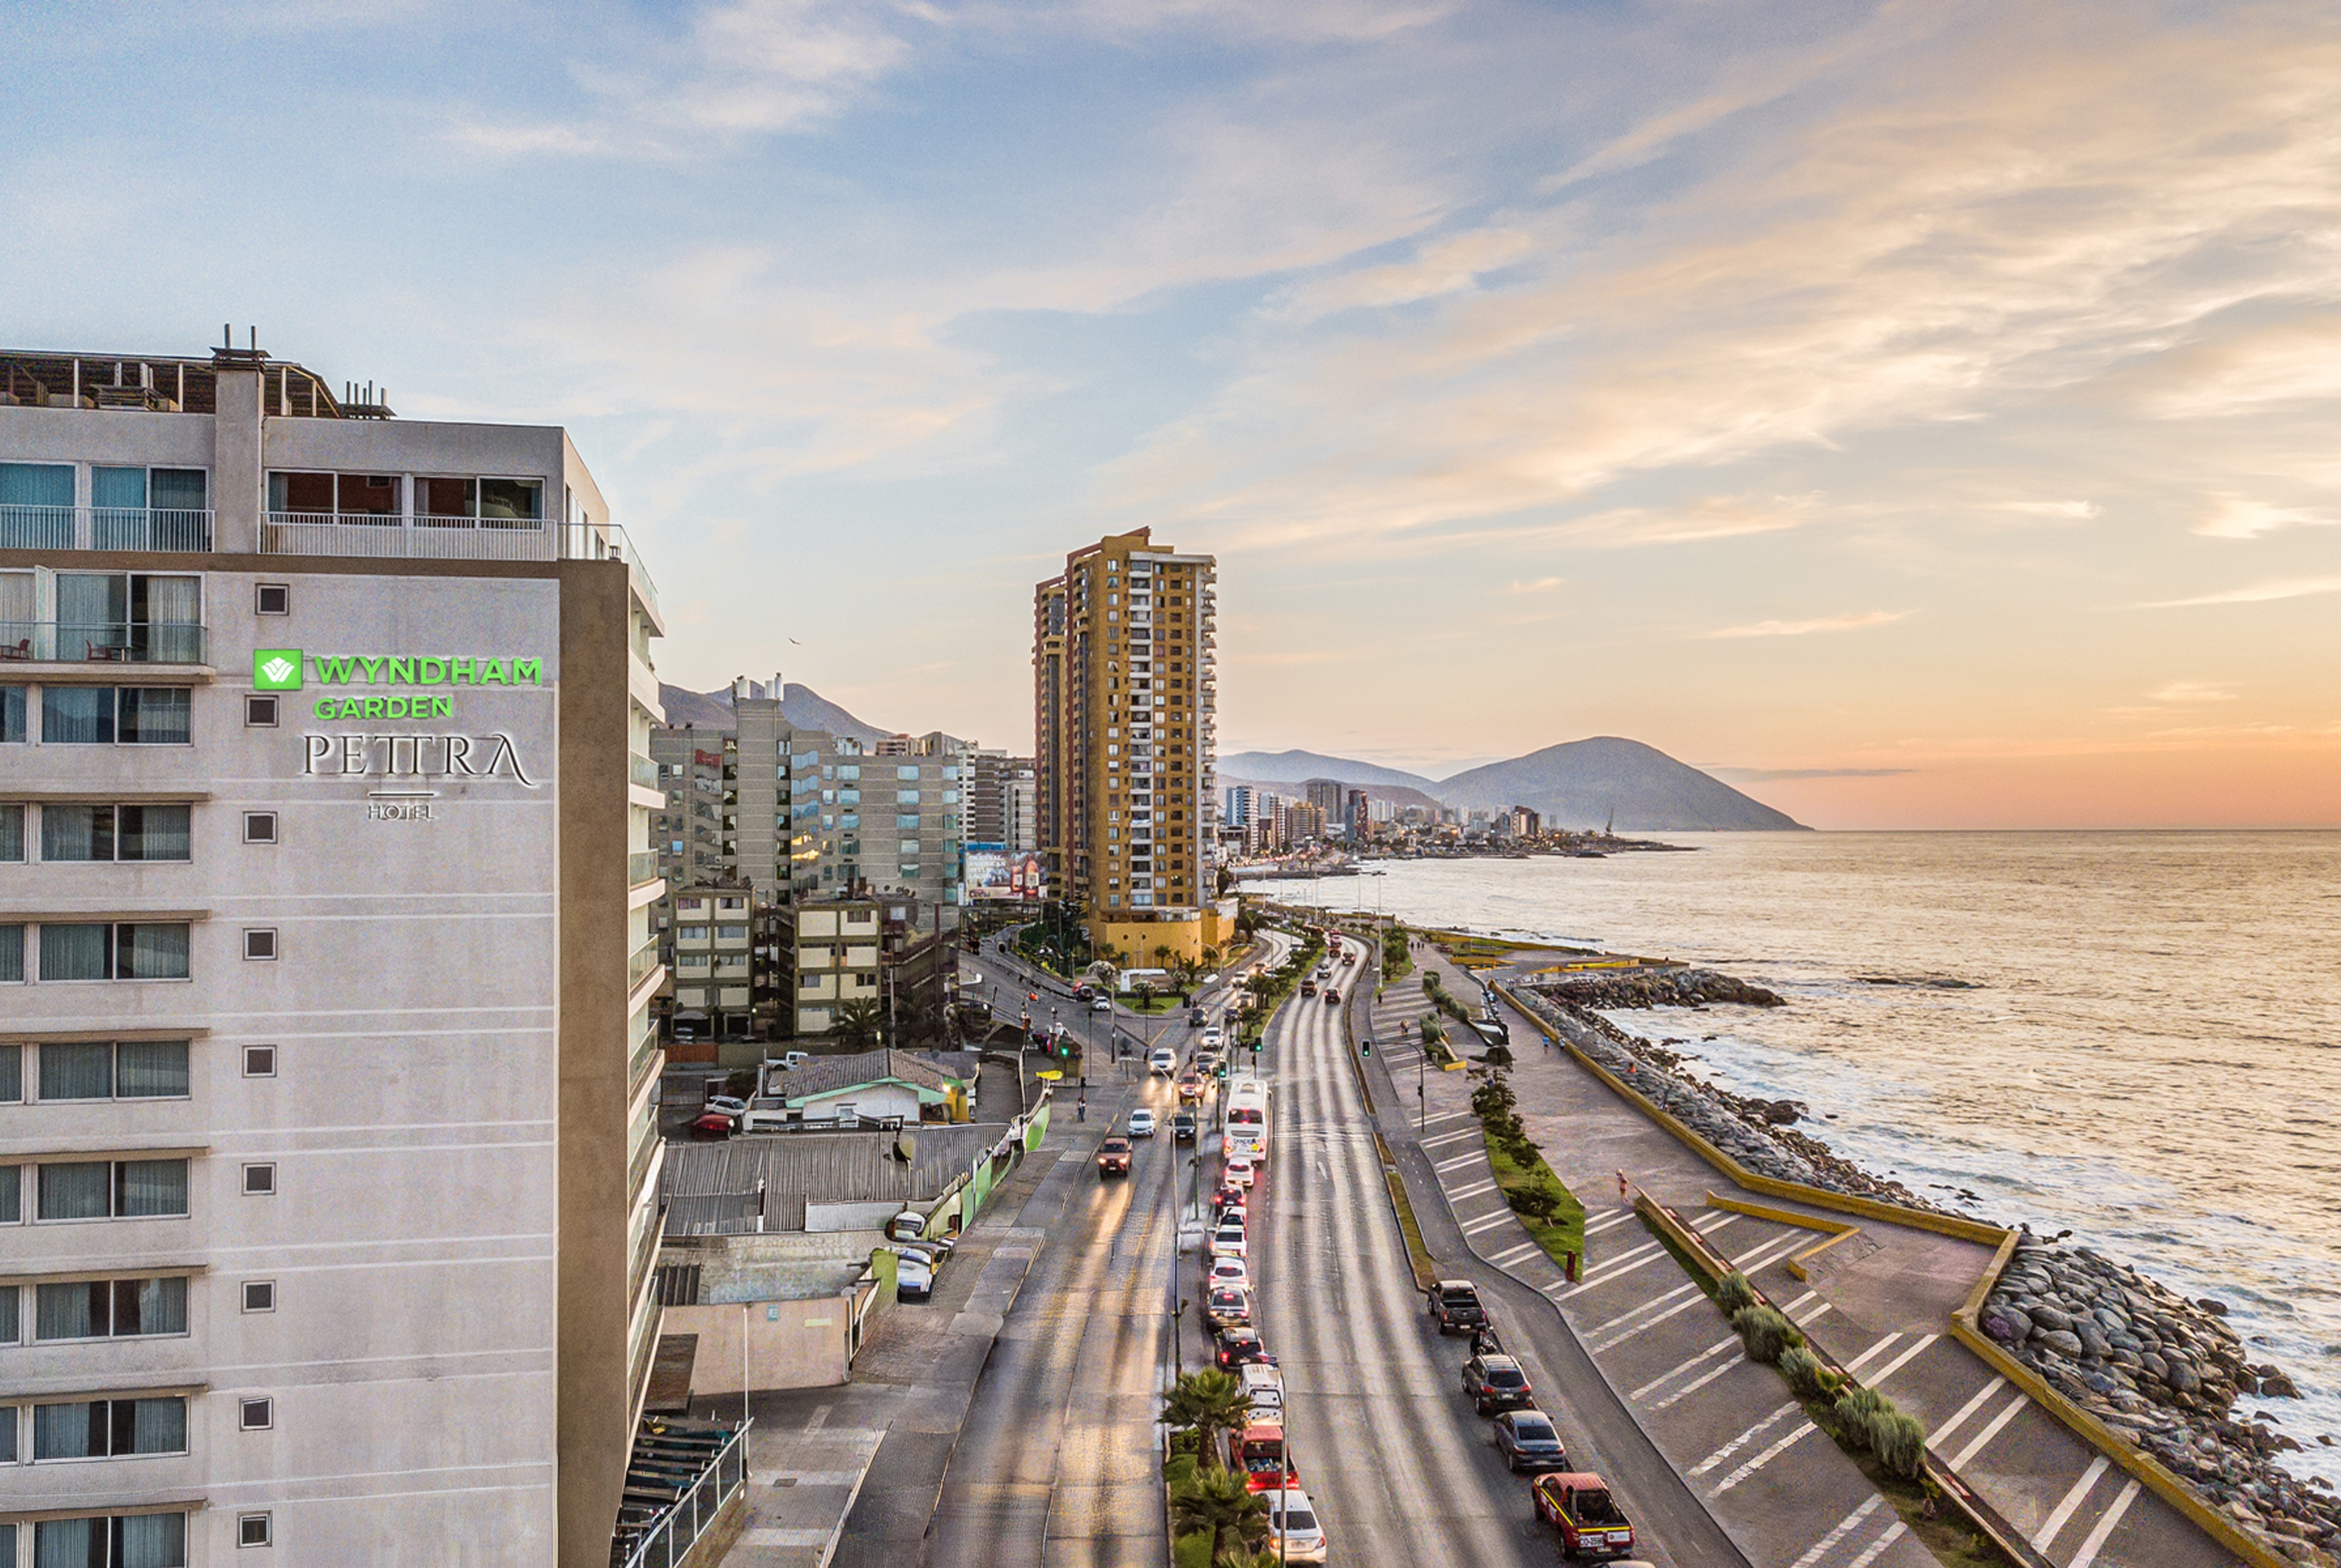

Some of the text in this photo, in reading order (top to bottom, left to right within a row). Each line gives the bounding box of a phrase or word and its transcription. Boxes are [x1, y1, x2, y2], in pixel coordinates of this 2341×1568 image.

[313, 656, 542, 686] WYNDHAM
[313, 696, 453, 720] GARDEN
[303, 733, 537, 787] PETTRA
[368, 804, 435, 820] HOTEL
